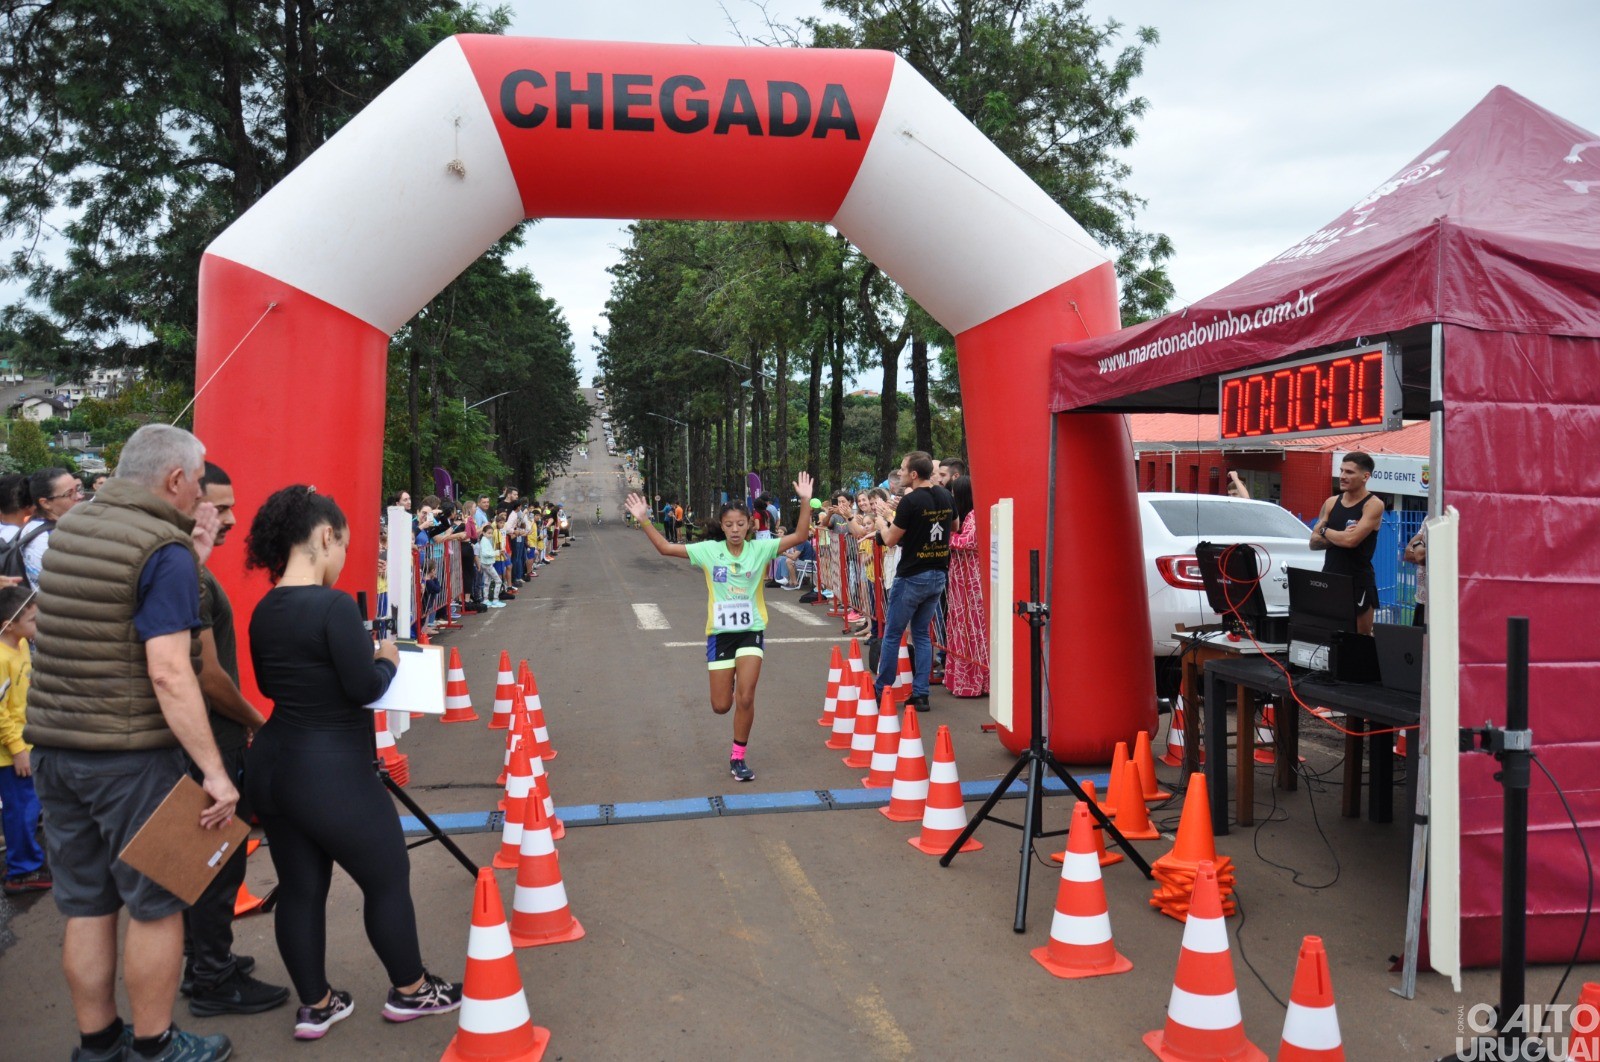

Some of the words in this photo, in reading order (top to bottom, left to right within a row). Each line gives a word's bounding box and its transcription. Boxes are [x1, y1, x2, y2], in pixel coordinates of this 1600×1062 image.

[499, 68, 861, 141] CHEGADA
[1097, 289, 1319, 375] www.maratonadovinho.com.br
[1371, 470, 1383, 480] GO
[1383, 471, 1393, 481] DE
[1393, 472, 1416, 482] GENTE
[717, 611, 751, 627] 118
